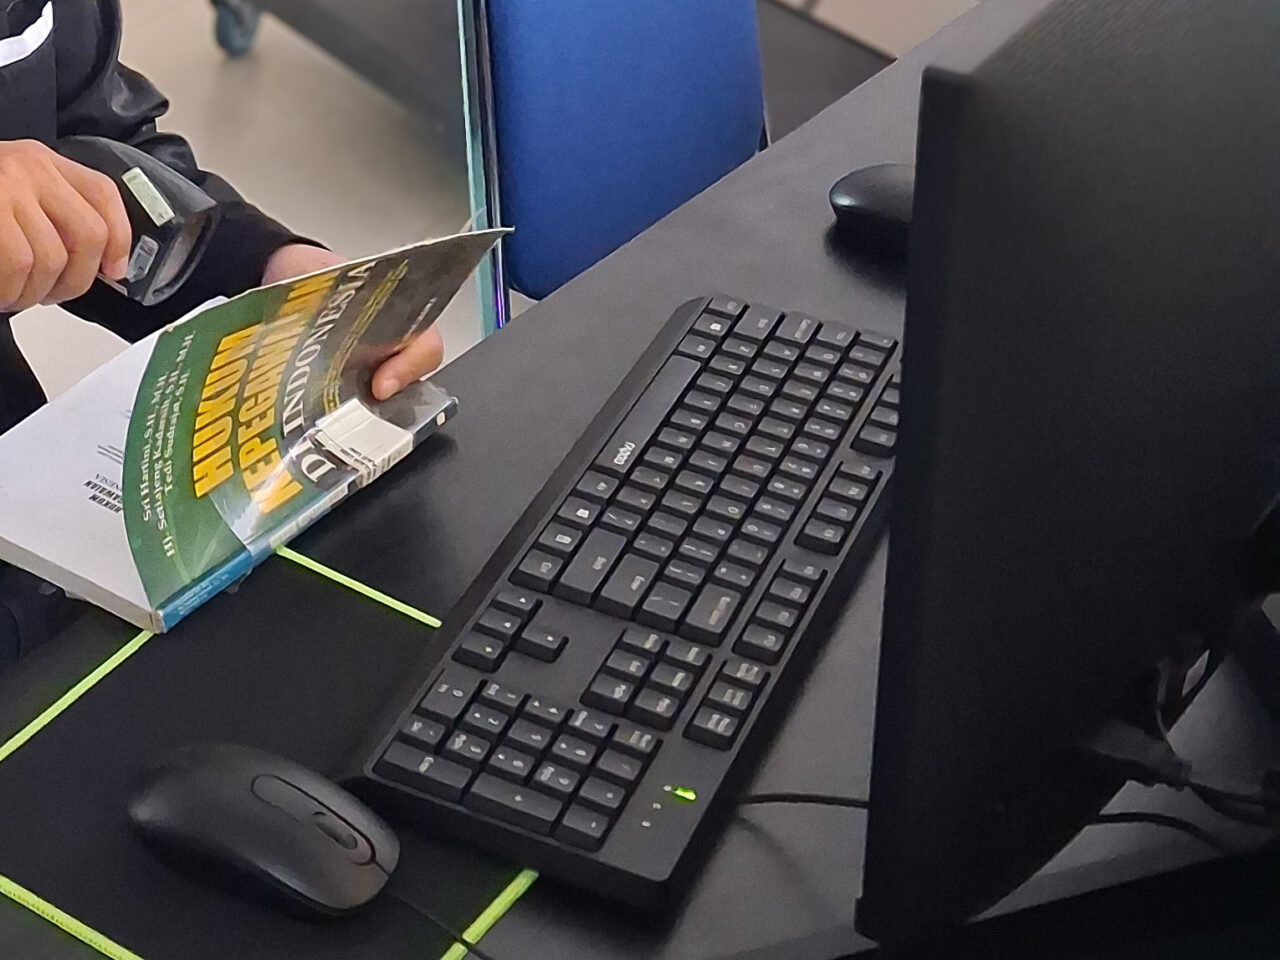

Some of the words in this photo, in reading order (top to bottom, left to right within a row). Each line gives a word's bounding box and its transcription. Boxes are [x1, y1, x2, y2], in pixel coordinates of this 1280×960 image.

[282, 261, 377, 439] INDONESIA
[192, 321, 262, 498] HUKUM
[141, 498, 152, 521] Sri
[164, 460, 173, 497] Tedi
